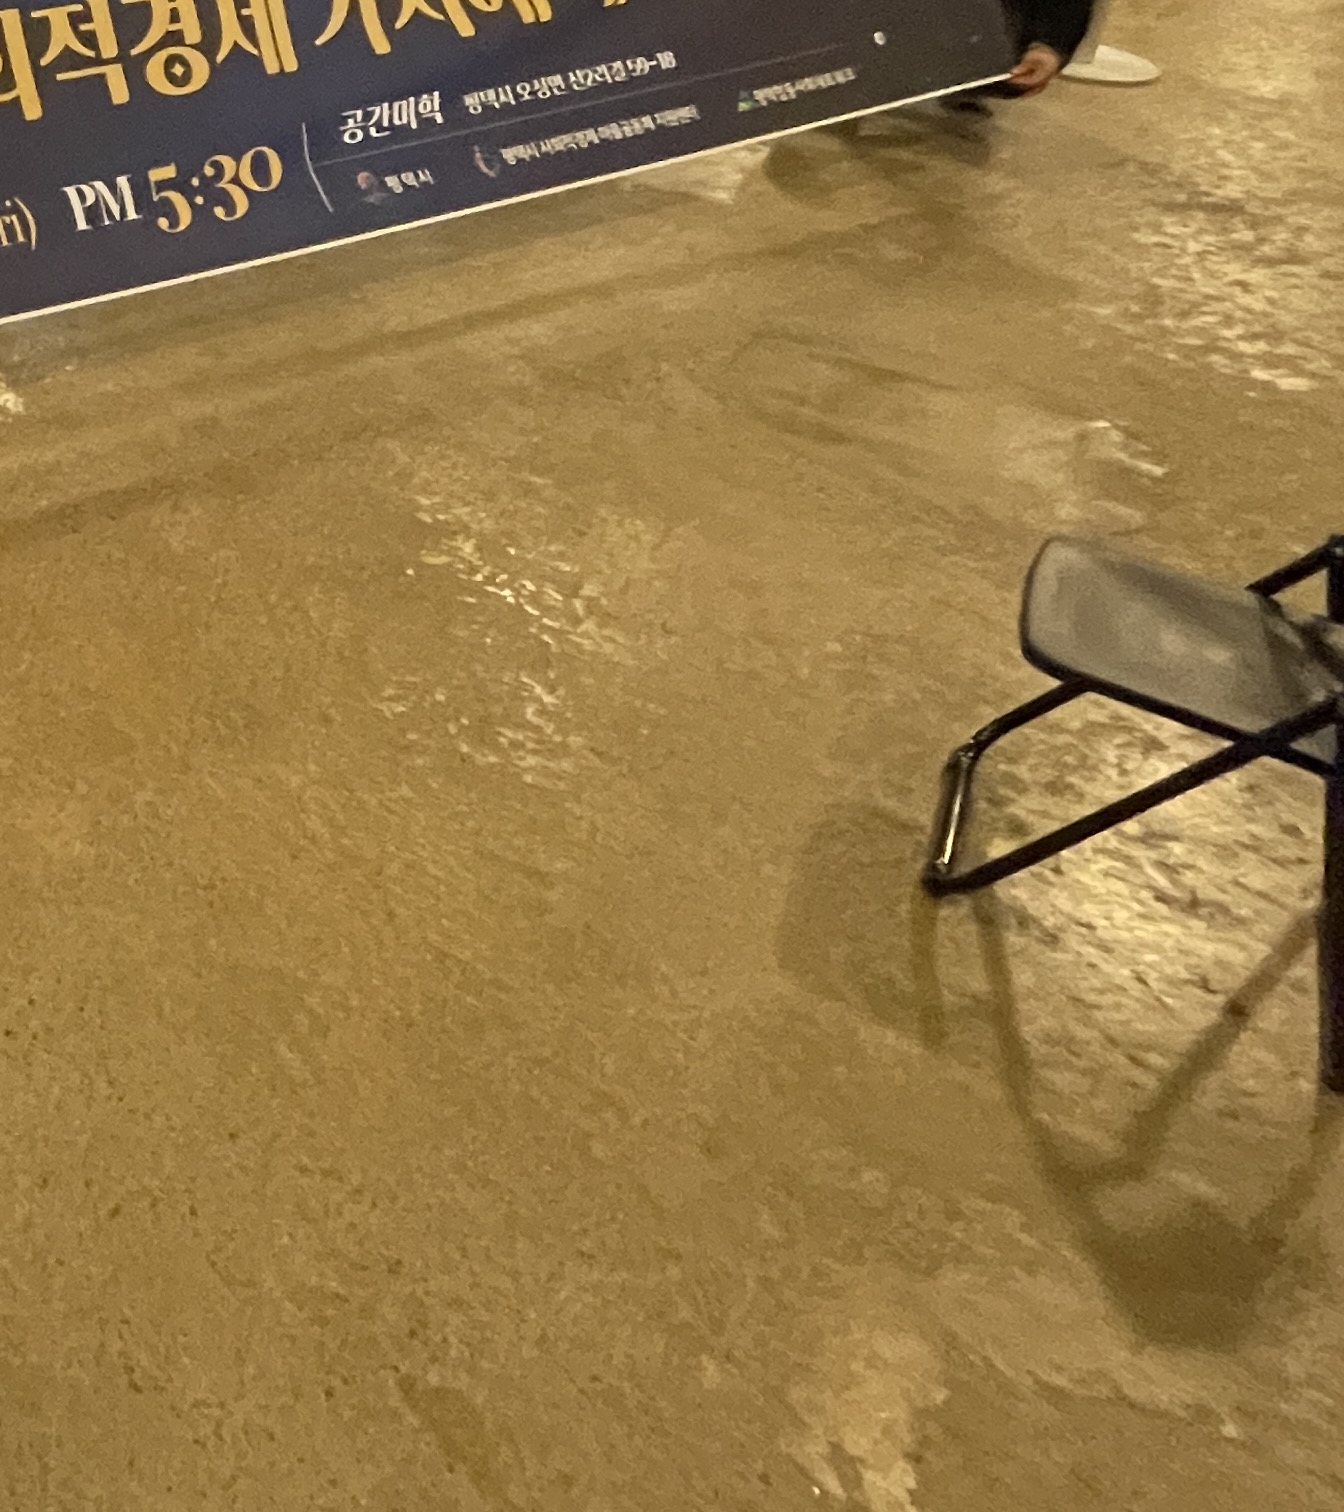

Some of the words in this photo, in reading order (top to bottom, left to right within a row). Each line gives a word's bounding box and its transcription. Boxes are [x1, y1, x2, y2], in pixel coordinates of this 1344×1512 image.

[338, 90, 445, 144] 공간미학
[60, 174, 144, 233] PM
[146, 145, 284, 234] 5:30
